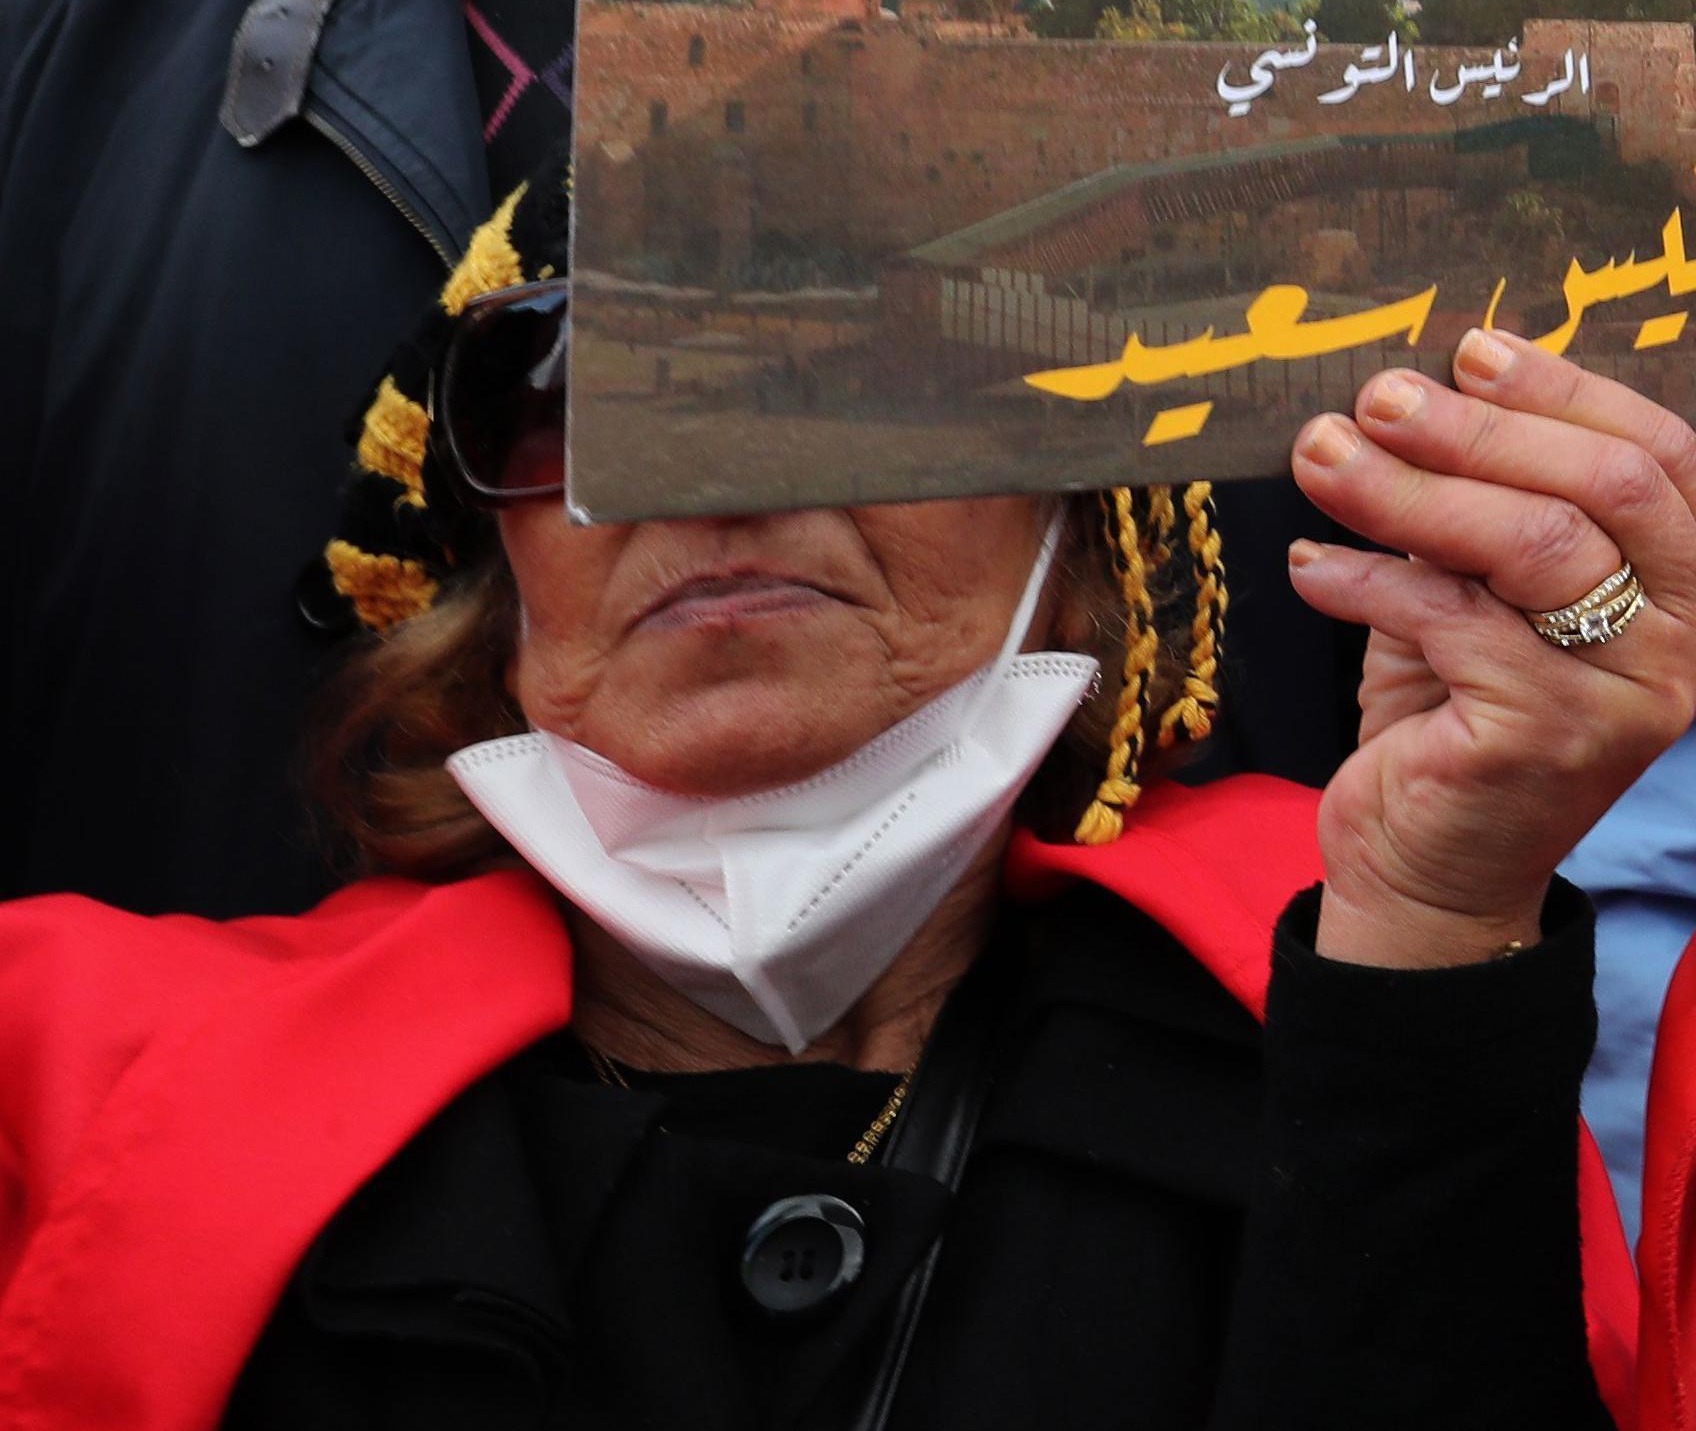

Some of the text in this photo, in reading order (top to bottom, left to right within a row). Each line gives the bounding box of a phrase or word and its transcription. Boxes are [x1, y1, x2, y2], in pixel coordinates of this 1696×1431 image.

[1216, 18, 1590, 117] الرئيس التونسي
[1023, 283, 1438, 446] سعيد
